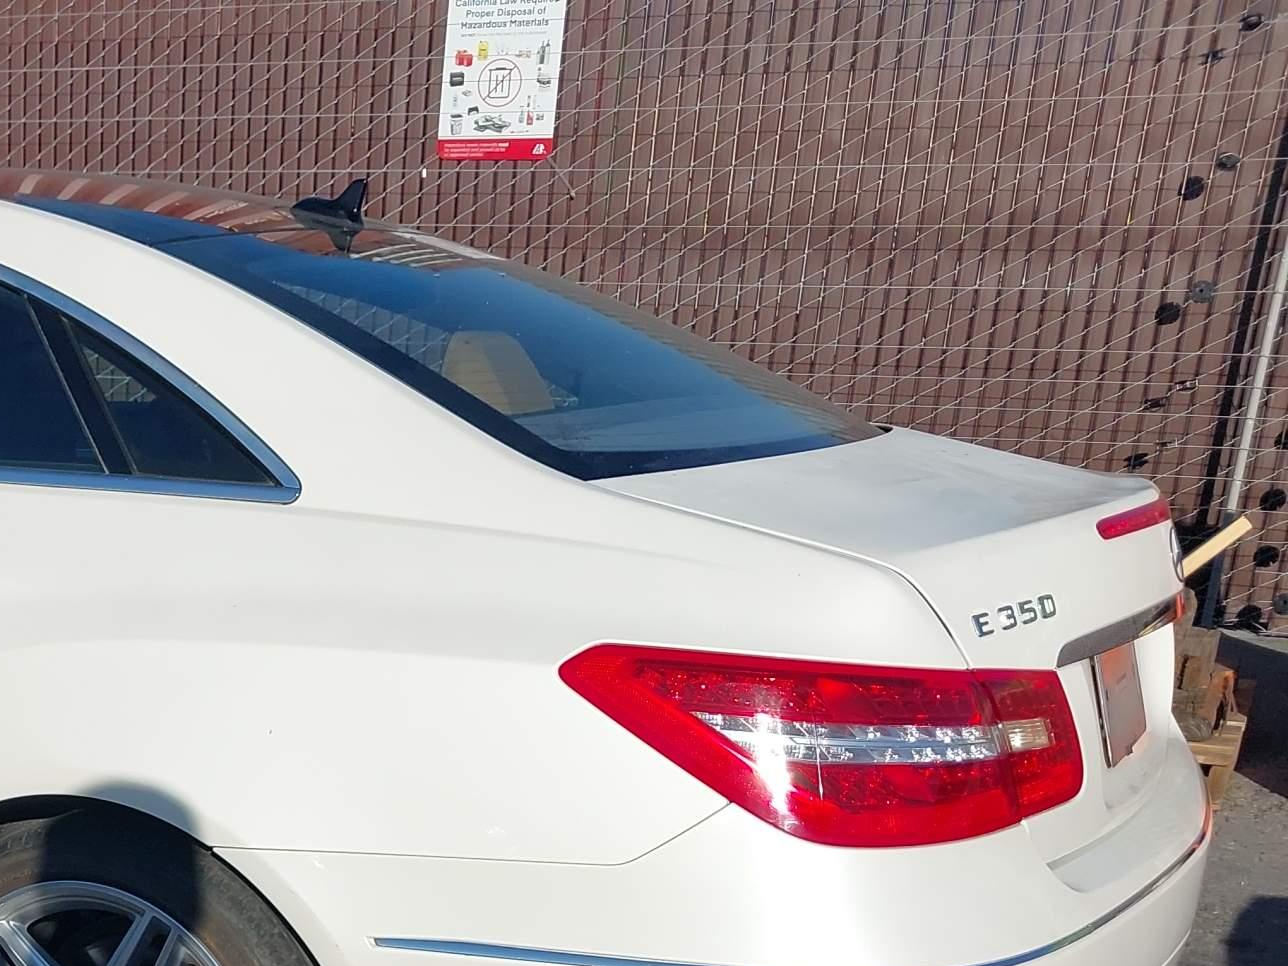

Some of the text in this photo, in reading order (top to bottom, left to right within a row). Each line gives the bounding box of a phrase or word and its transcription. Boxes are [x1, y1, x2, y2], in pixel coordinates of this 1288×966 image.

[466, 5, 547, 19] Proper Disposal of
[461, 18, 550, 30] Hazardous Materials
[970, 593, 1058, 638] E 350
